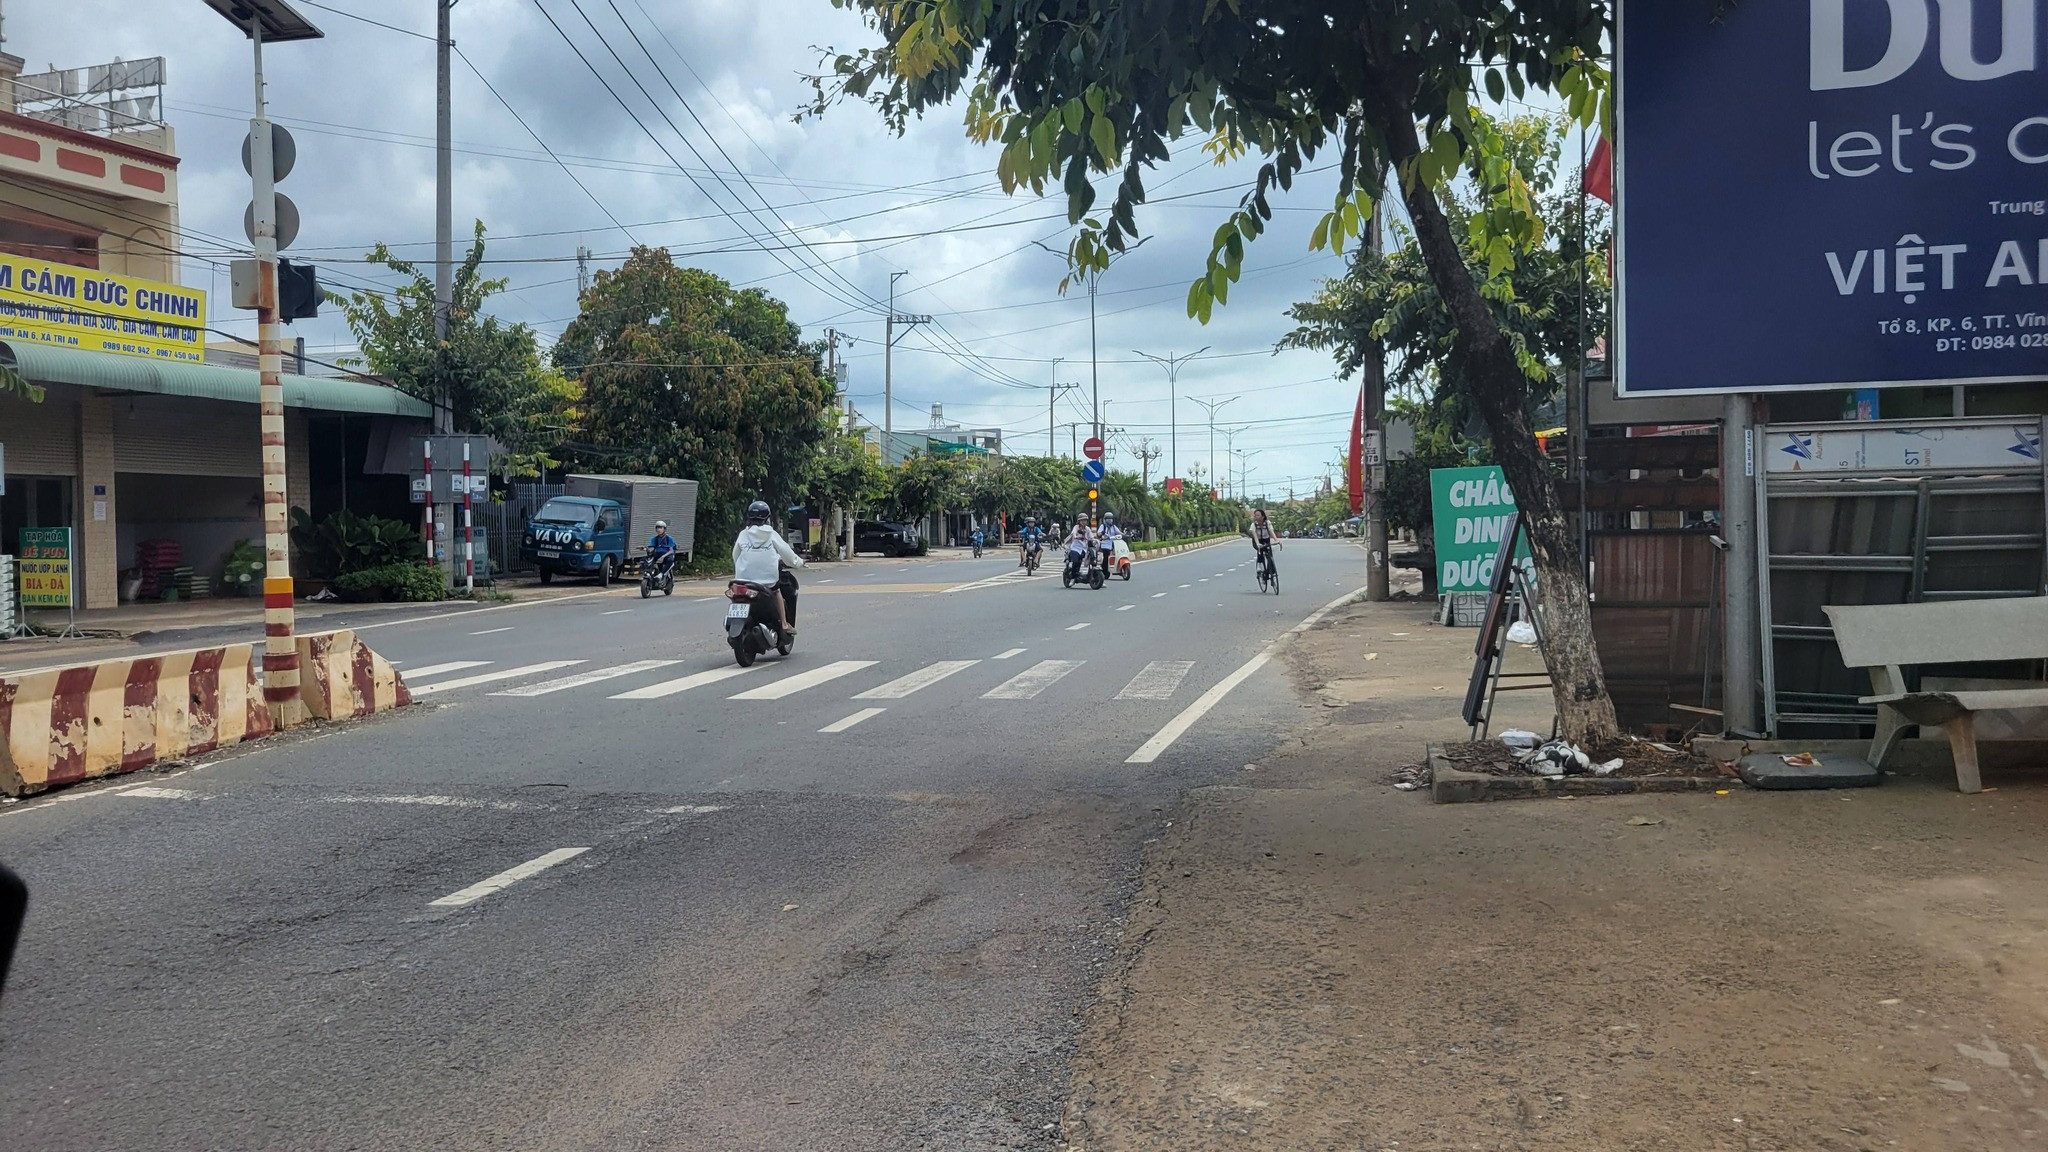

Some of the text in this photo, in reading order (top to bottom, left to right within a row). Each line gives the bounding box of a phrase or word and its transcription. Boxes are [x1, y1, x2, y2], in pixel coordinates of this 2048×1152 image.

[1808, 111, 1977, 179] let's
[1988, 199, 2046, 216] Trung
[1824, 233, 1968, 304] VIỆT
[21, 267, 76, 299] CÁM
[83, 278, 128, 307] ĐỨC
[136, 288, 198, 319] CHINH
[123, 317, 137, 334] GIA
[1878, 312, 2048, 335] Tổ 8, KP. 6, TT. Vĩn
[102, 341, 121, 351] 0989
[123, 343, 136, 353] 602
[137, 345, 150, 355] 942
[1936, 337, 1966, 352] ĐT:
[1971, 335, 2015, 350] 0984
[26, 532, 43, 544] TẠP
[25, 578, 43, 590] BIA
